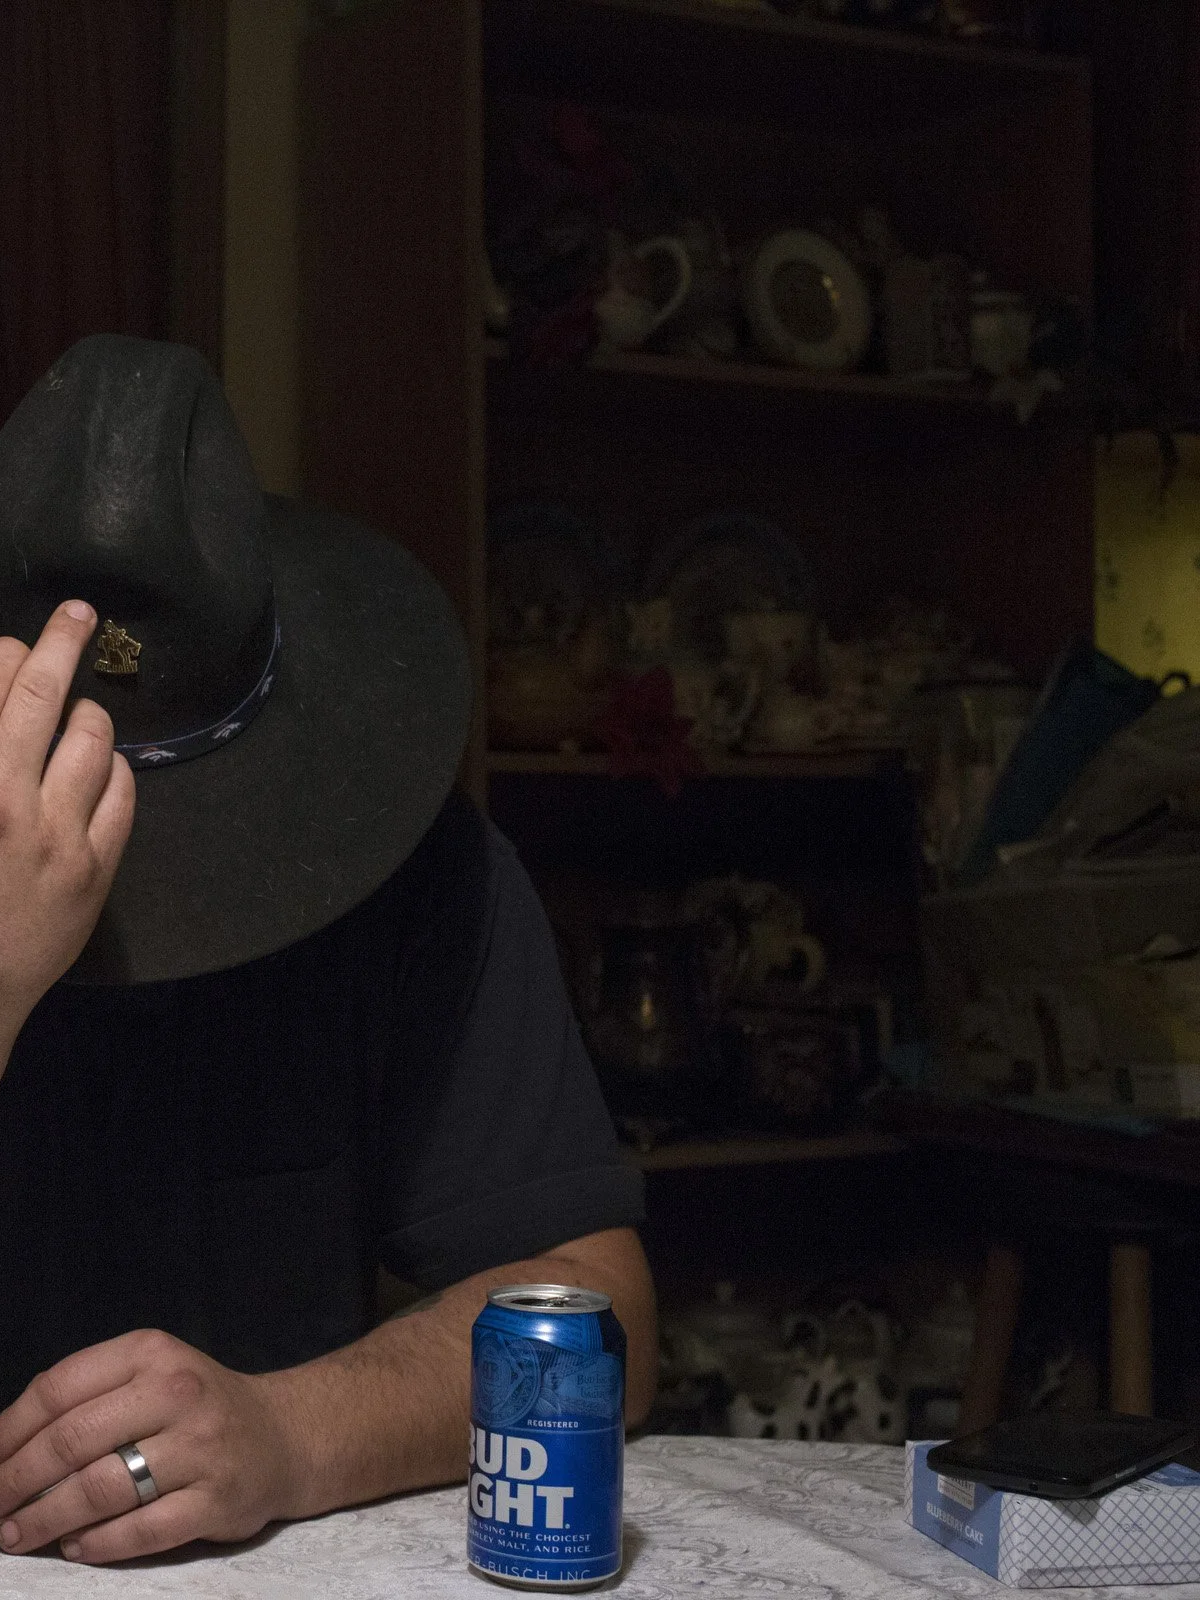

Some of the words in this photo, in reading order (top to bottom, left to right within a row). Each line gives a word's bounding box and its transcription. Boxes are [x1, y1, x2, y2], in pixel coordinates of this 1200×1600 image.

[527, 1419, 579, 1428] REGISTERED
[468, 1470, 574, 1529] GHT
[926, 1501, 964, 1532] BLUEBERRY
[965, 1525, 984, 1546] CAKE
[470, 1530, 493, 1543] ARLEY
[498, 1539, 530, 1552] MALT,
[534, 1545, 560, 1553] AND
[565, 1545, 591, 1553] RICE
[510, 1530, 531, 1540] THE
[535, 1533, 591, 1542] CHOICEST
